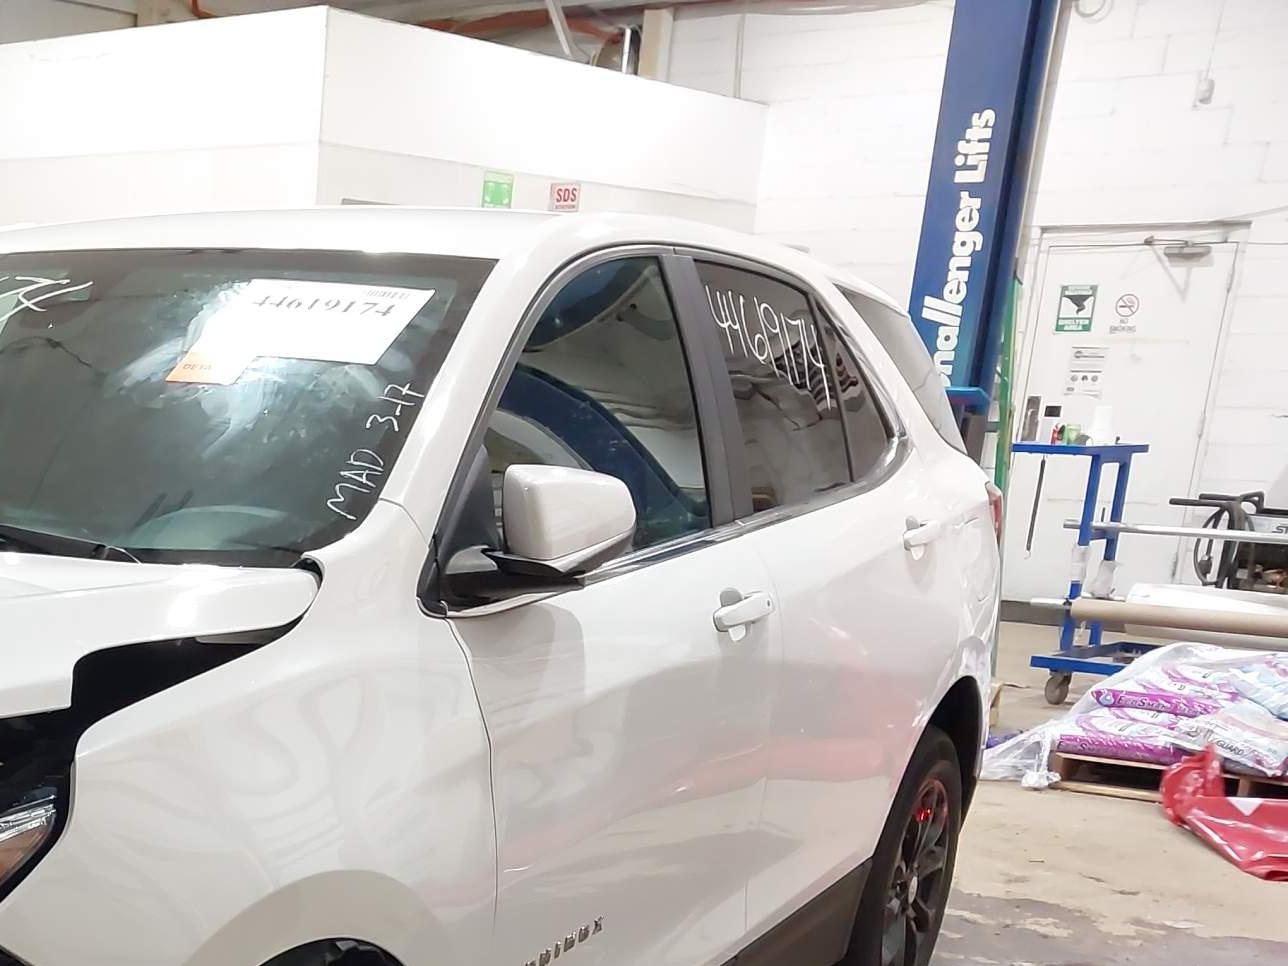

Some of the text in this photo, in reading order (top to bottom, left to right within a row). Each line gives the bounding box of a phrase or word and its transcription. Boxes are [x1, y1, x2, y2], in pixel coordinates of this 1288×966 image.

[555, 187, 577, 203] SDS
[921, 108, 996, 387] hallenger Lifts
